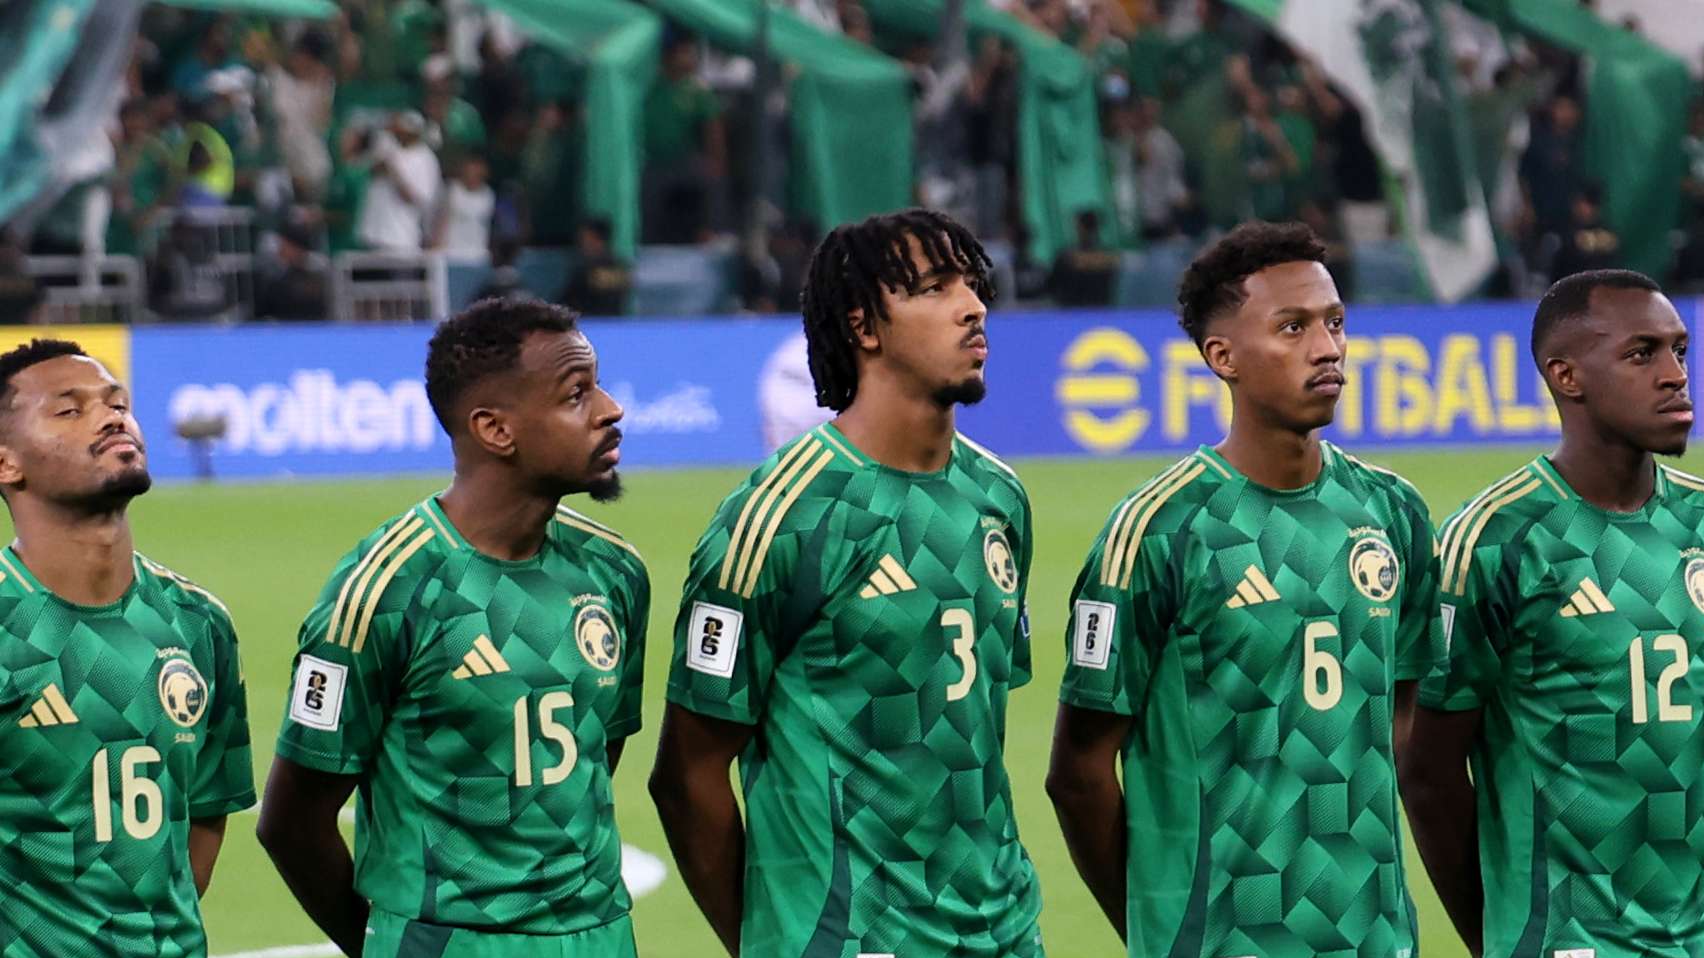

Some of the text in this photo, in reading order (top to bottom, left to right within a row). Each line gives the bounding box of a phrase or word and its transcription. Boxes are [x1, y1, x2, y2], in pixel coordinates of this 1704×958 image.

[168, 369, 435, 455] molten
[940, 608, 977, 702] 3
[1303, 621, 1343, 711] 6
[1629, 634, 1693, 724] 12
[514, 691, 578, 788] 15
[92, 745, 164, 843] 16
